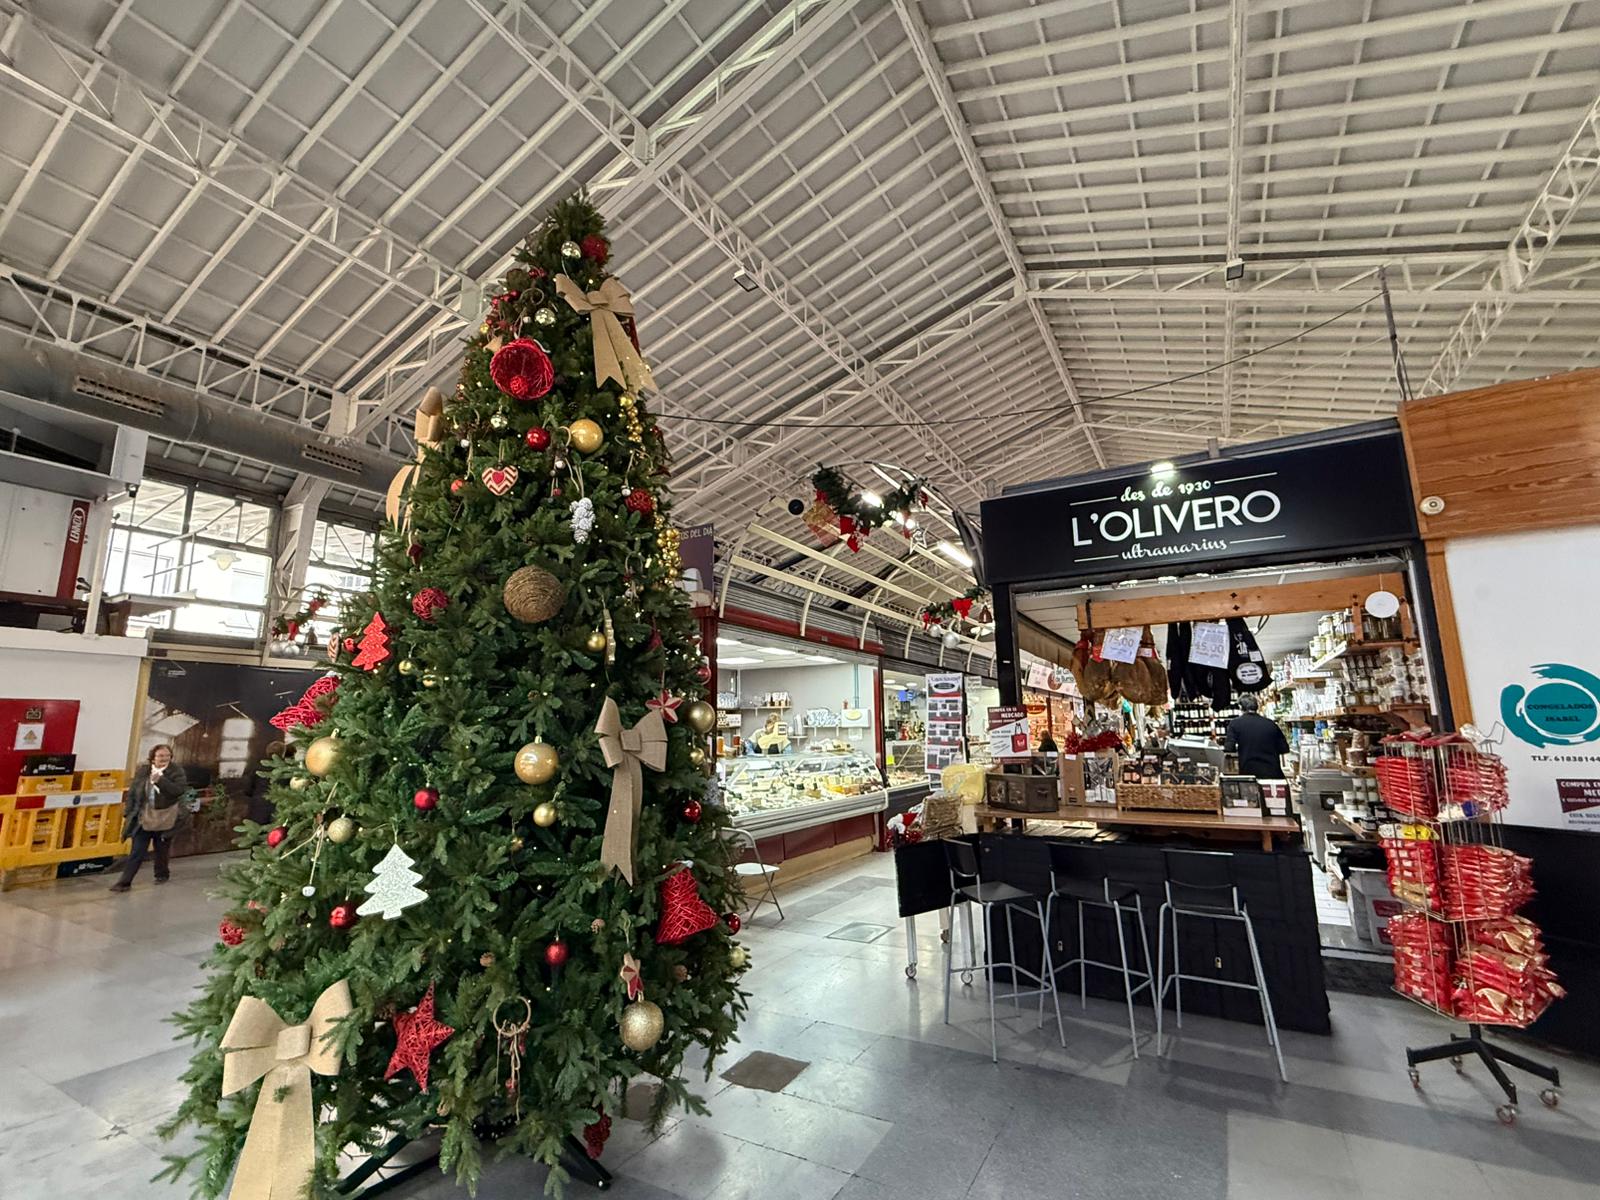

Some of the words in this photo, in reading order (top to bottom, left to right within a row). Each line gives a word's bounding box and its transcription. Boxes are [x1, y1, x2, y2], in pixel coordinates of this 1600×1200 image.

[1178, 480, 1211, 495] 1930
[1072, 489, 1281, 547] L'OLIVERO
[1121, 538, 1228, 560] ultramarins
[1526, 703, 1595, 711] CONGELADOS
